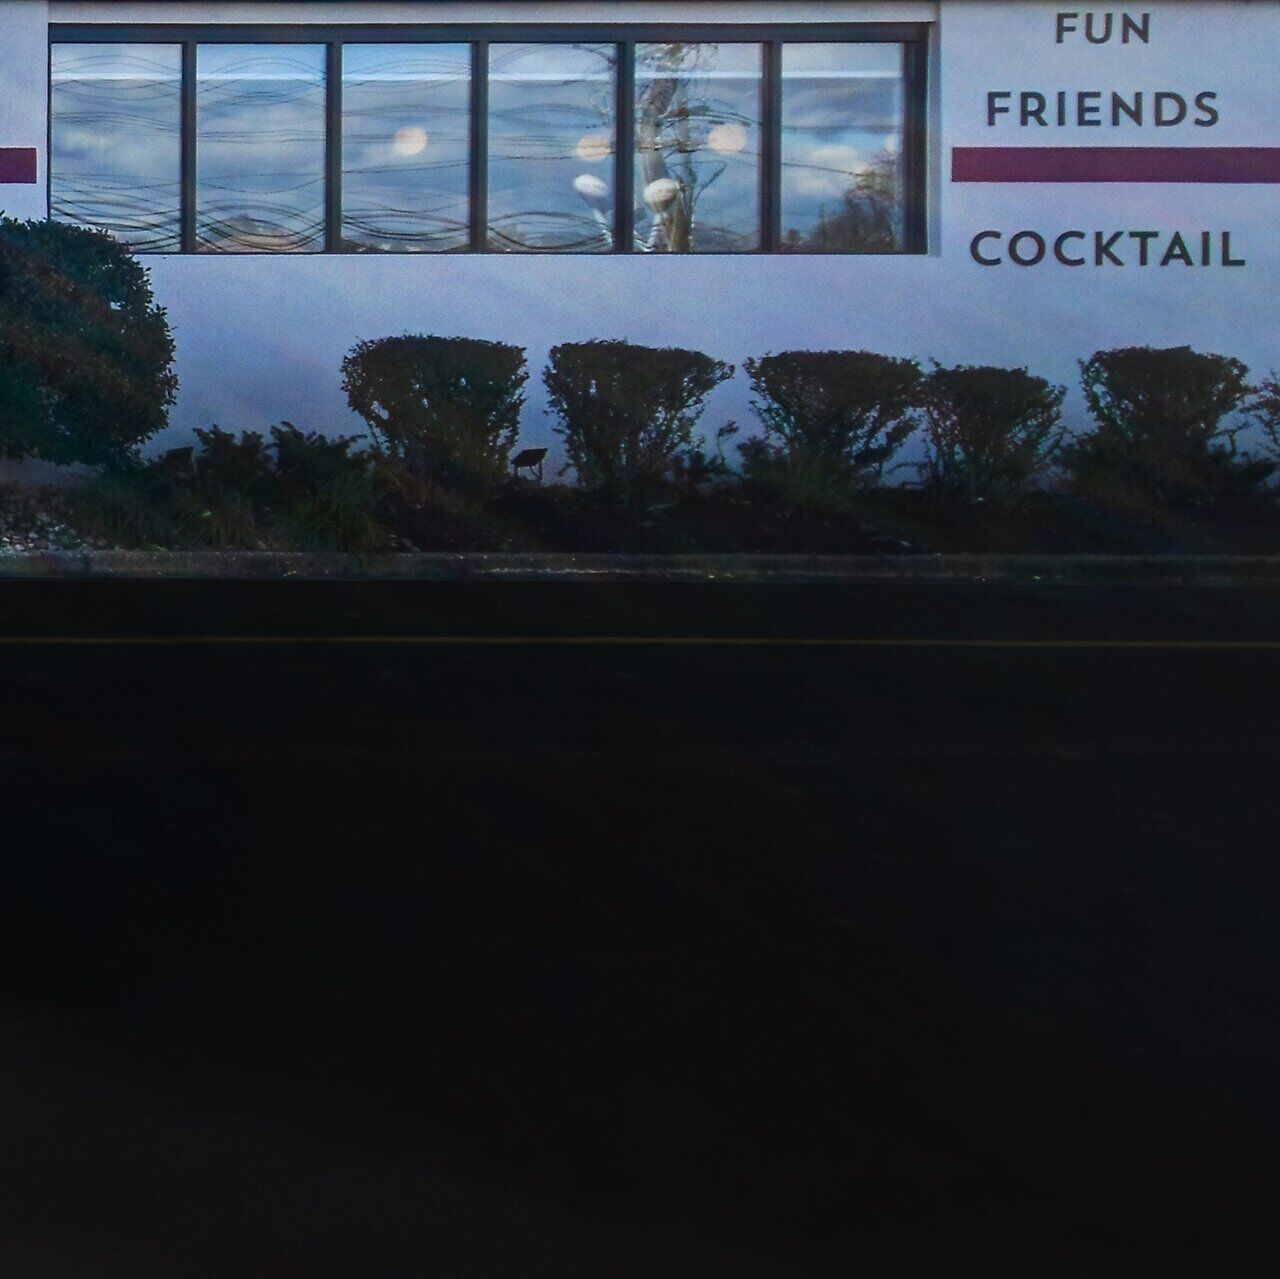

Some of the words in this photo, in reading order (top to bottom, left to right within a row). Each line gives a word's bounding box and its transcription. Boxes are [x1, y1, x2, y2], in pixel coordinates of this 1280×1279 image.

[1056, 12, 1151, 45] FUN
[986, 90, 1220, 128] FRIENDS
[969, 230, 1246, 267] COCKTAIL
